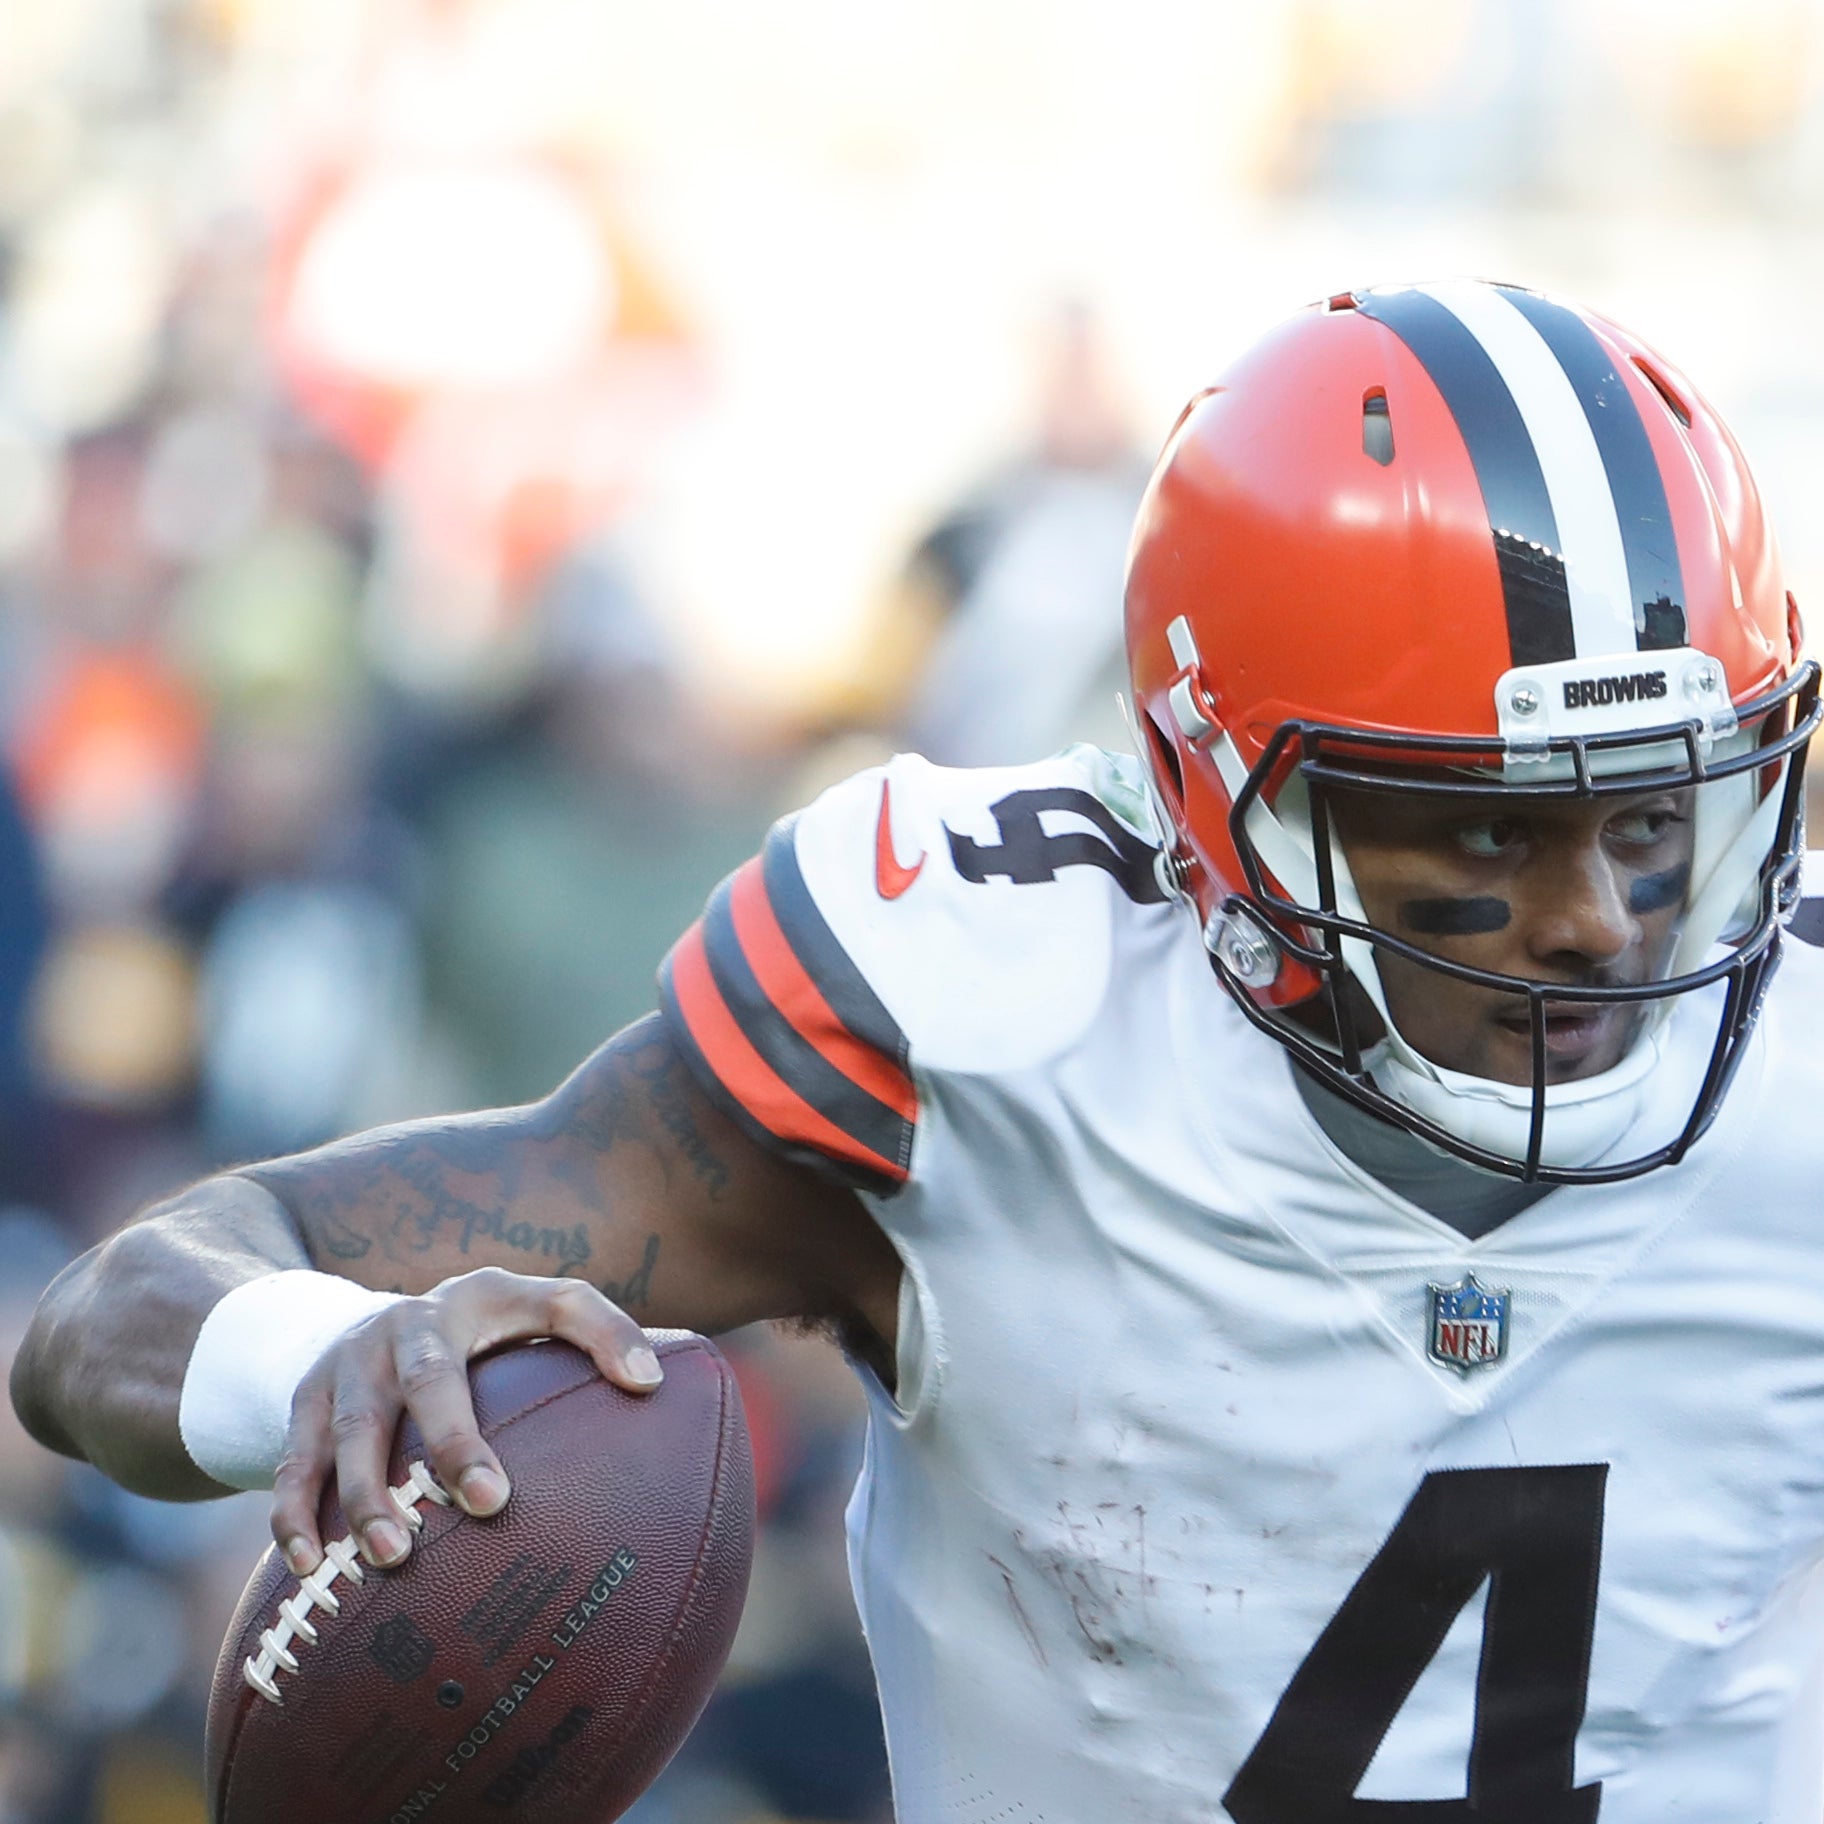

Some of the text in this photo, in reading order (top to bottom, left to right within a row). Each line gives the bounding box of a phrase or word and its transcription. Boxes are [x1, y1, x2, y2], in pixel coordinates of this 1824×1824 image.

[1563, 671, 1667, 709] BROWNS
[941, 787, 1175, 905] 4
[1439, 1323, 1497, 1360] NFL
[446, 1655, 555, 1773] FOOTBALL
[552, 1549, 636, 1648] LEAGUE
